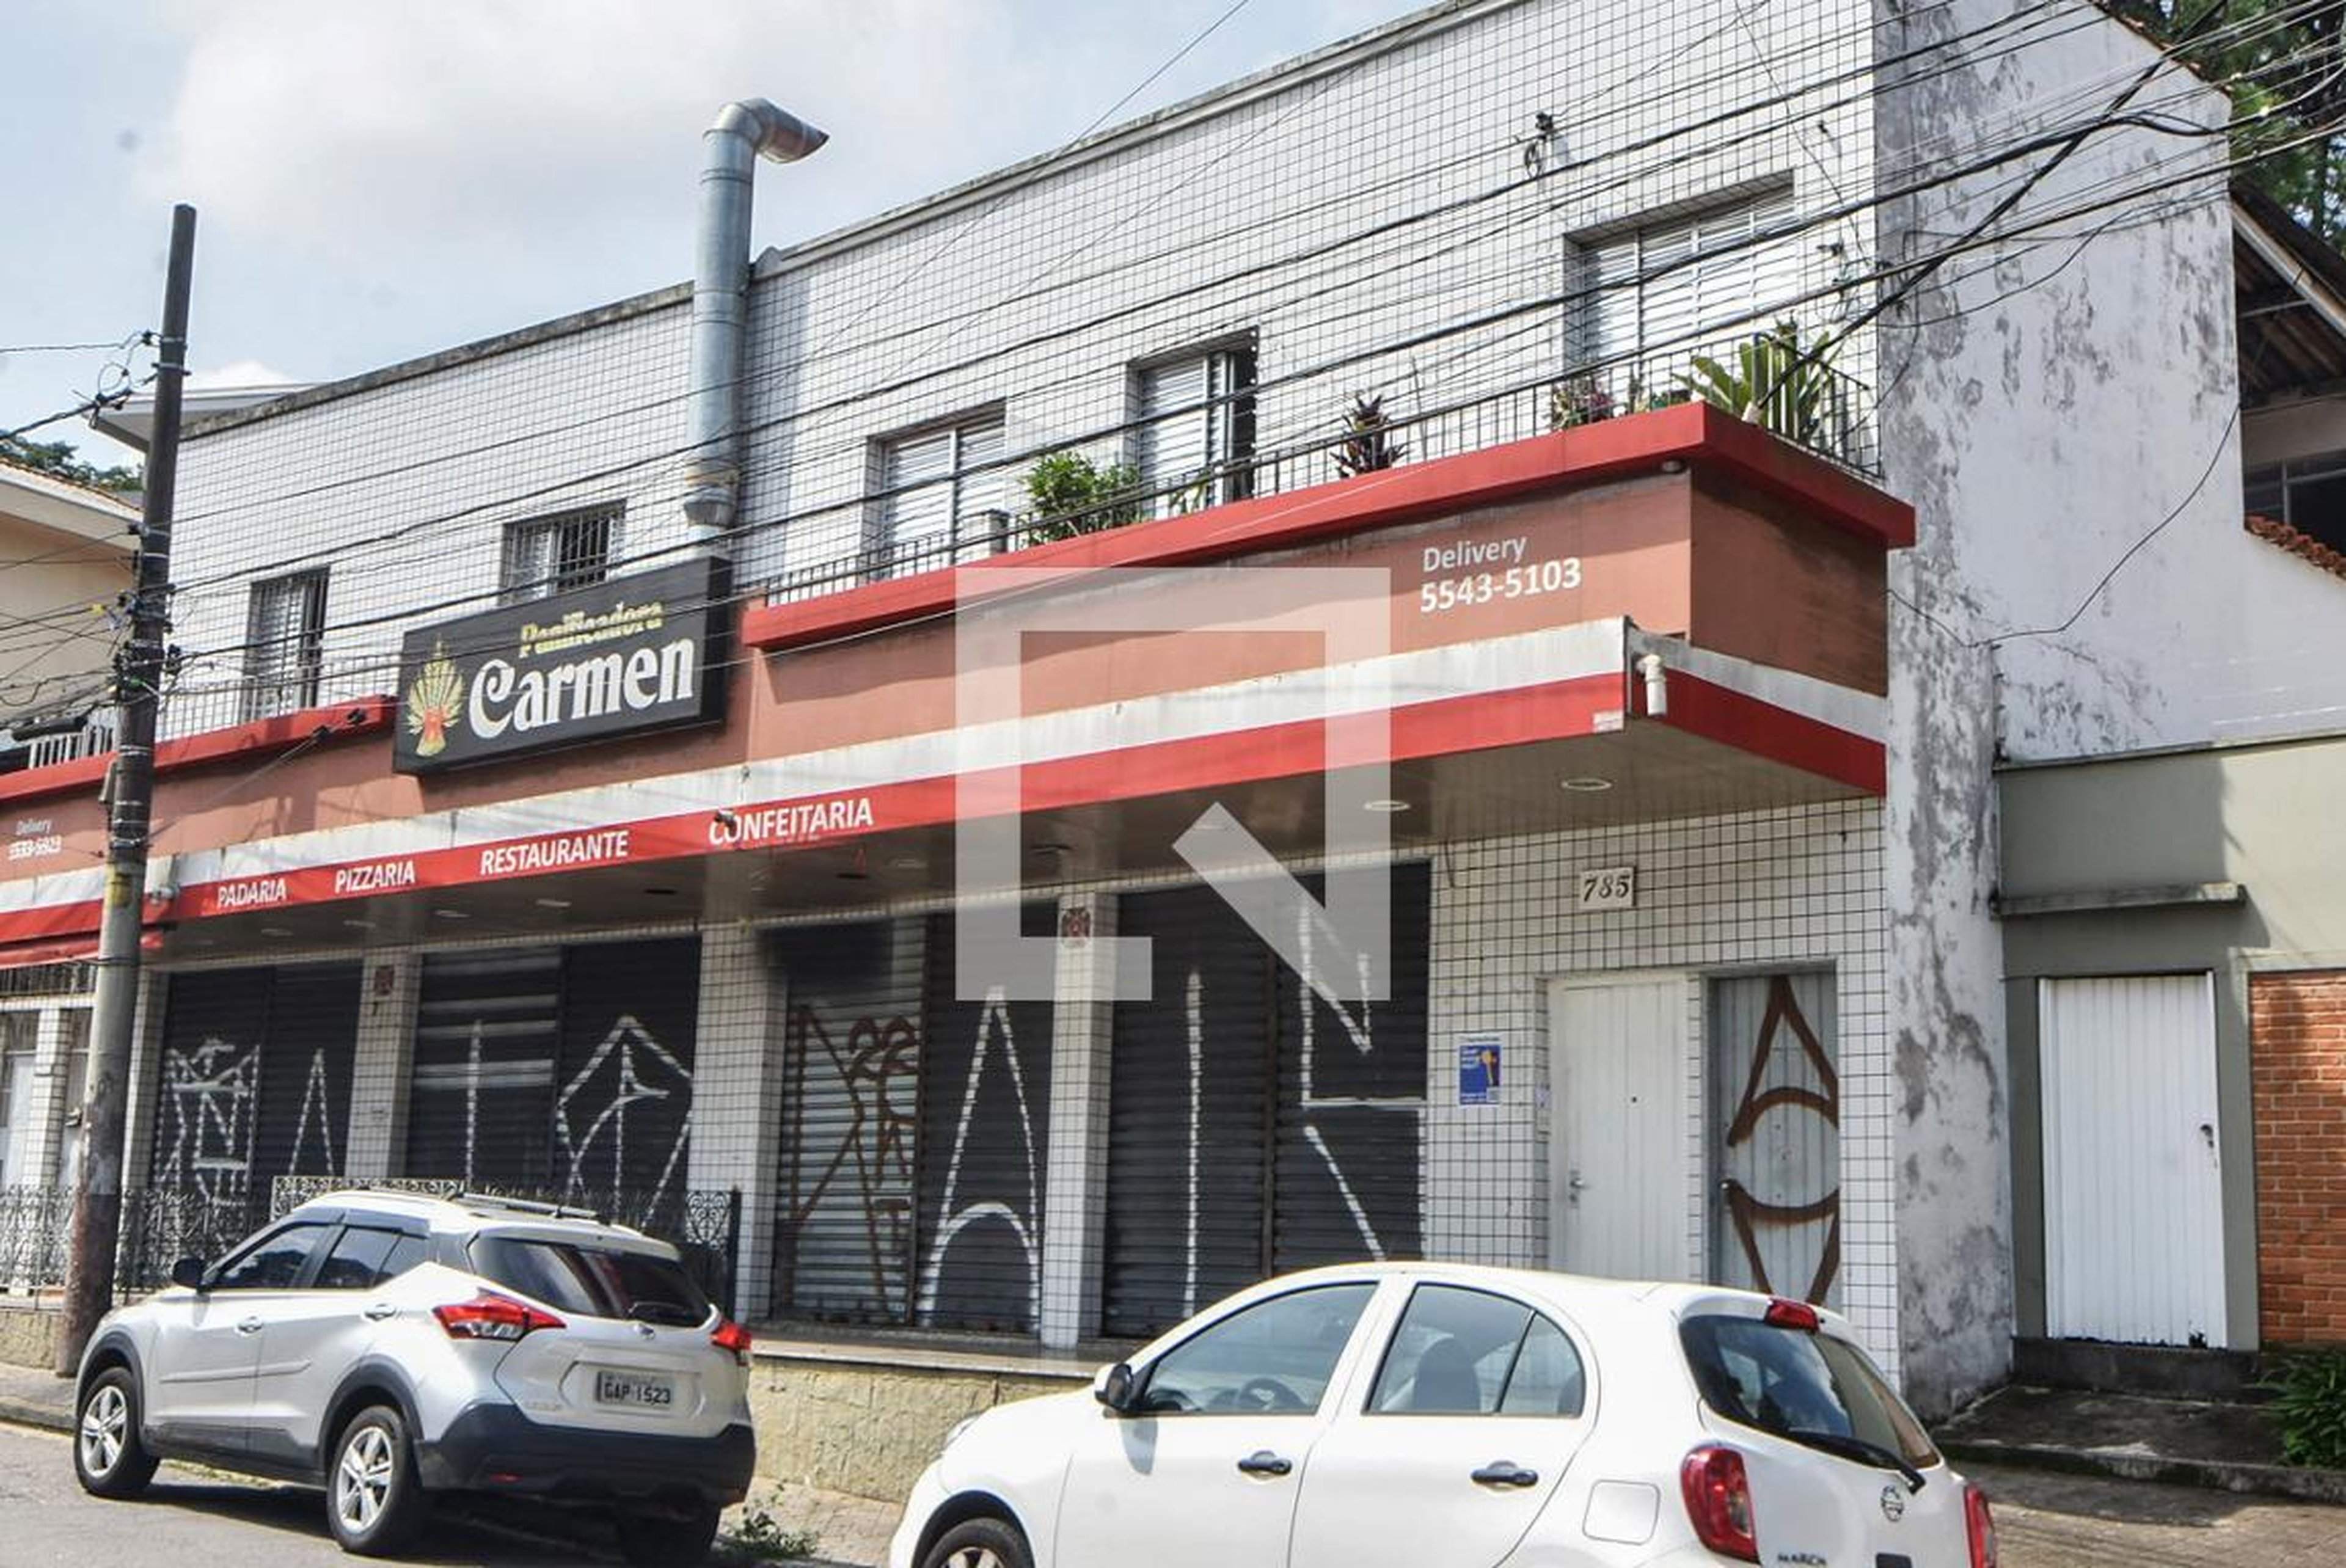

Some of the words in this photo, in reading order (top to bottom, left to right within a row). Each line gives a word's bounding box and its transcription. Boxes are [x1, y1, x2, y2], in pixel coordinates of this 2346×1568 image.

[1423, 536, 1527, 572] Delivery
[1420, 558, 1581, 613] 5543-5103
[469, 638, 694, 738] Carmen
[480, 831, 629, 875] RESTAURANTE
[217, 878, 287, 909] PADARIA
[335, 861, 415, 894] PIZZARIA
[1583, 875, 1631, 902] 785
